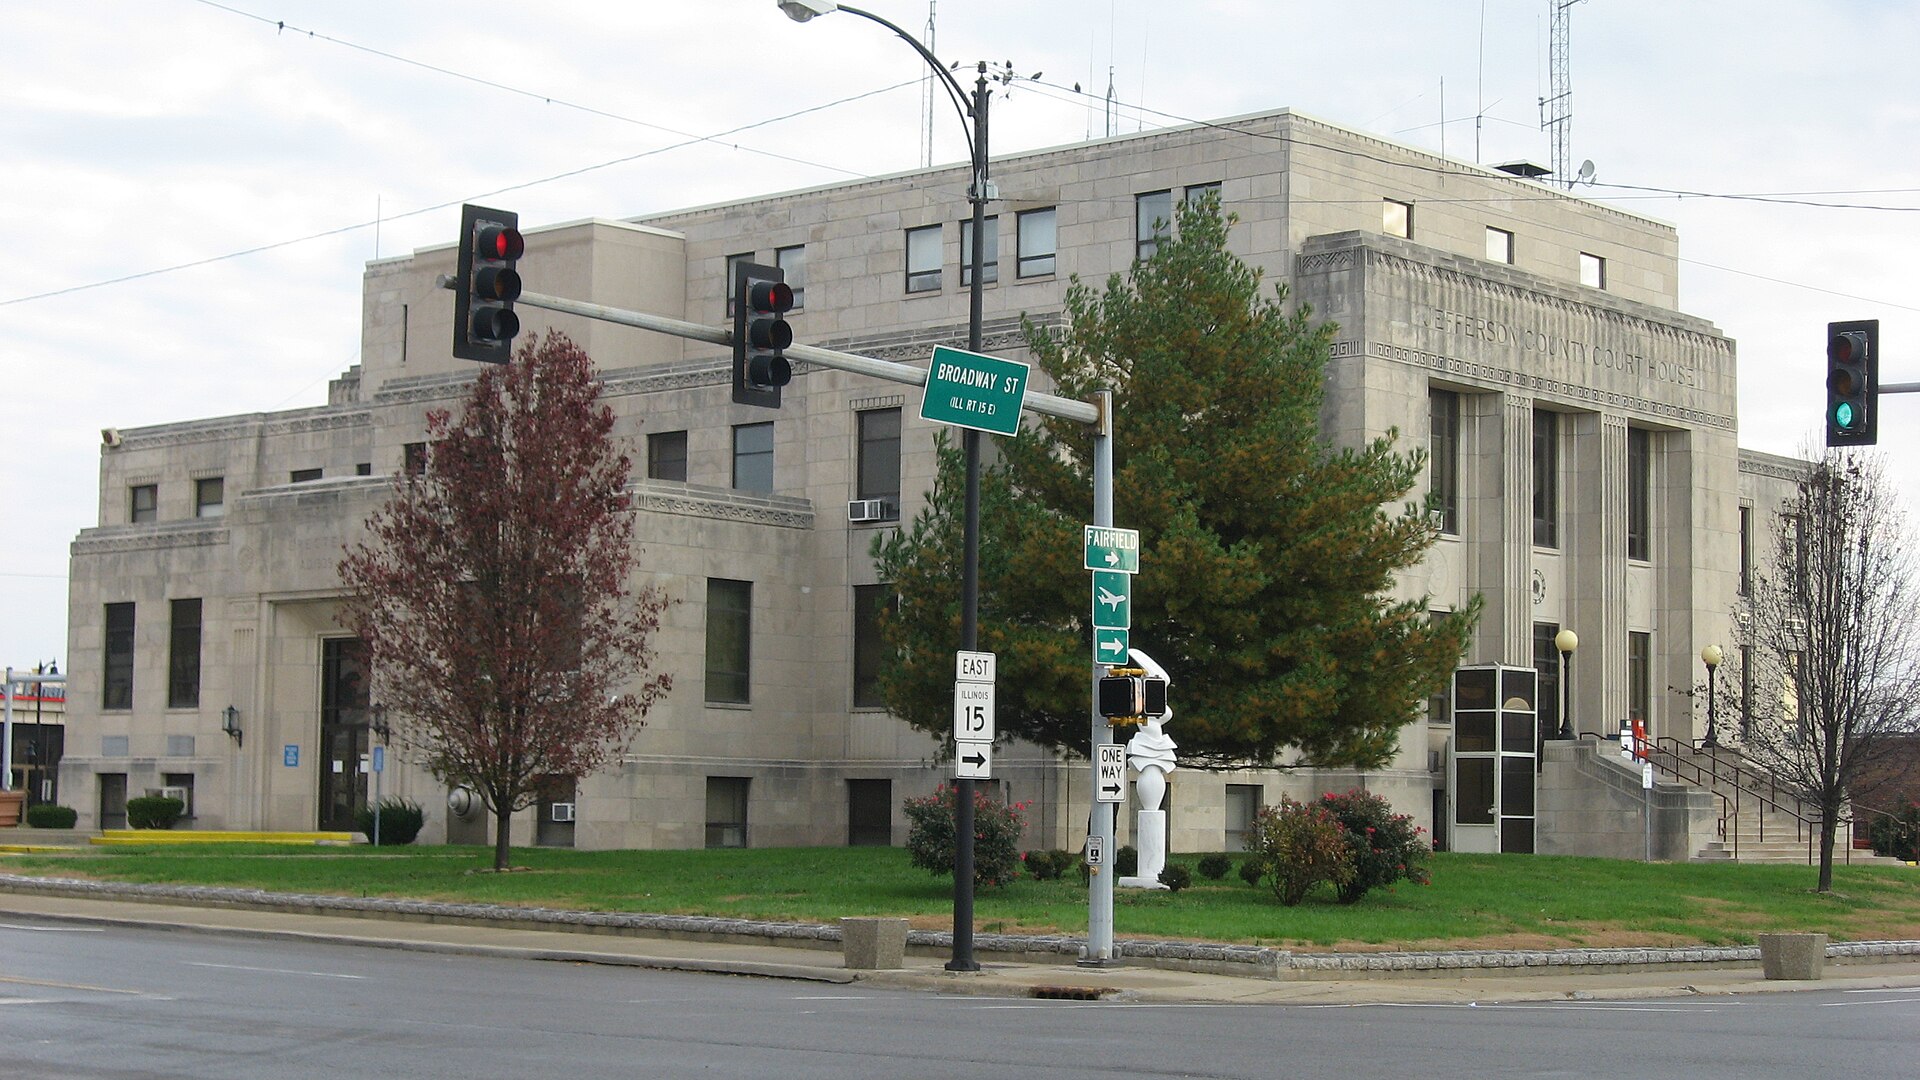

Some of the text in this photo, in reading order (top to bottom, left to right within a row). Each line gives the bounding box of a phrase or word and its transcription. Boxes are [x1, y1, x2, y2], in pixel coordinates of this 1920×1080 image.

[1423, 306, 1695, 387] JEFFERSON COUNTY COURT HOUSE
[937, 363, 1019, 395] BROADWAY ST
[949, 396, 996, 416] (ILL RT 15 E)
[1087, 530, 1137, 550] FAIRFIELD
[963, 658, 989, 676] EAST
[961, 690, 989, 700] ILLINOIS
[965, 705, 985, 732] 15
[1101, 749, 1122, 762] ONE
[1101, 765, 1122, 779] WAY
